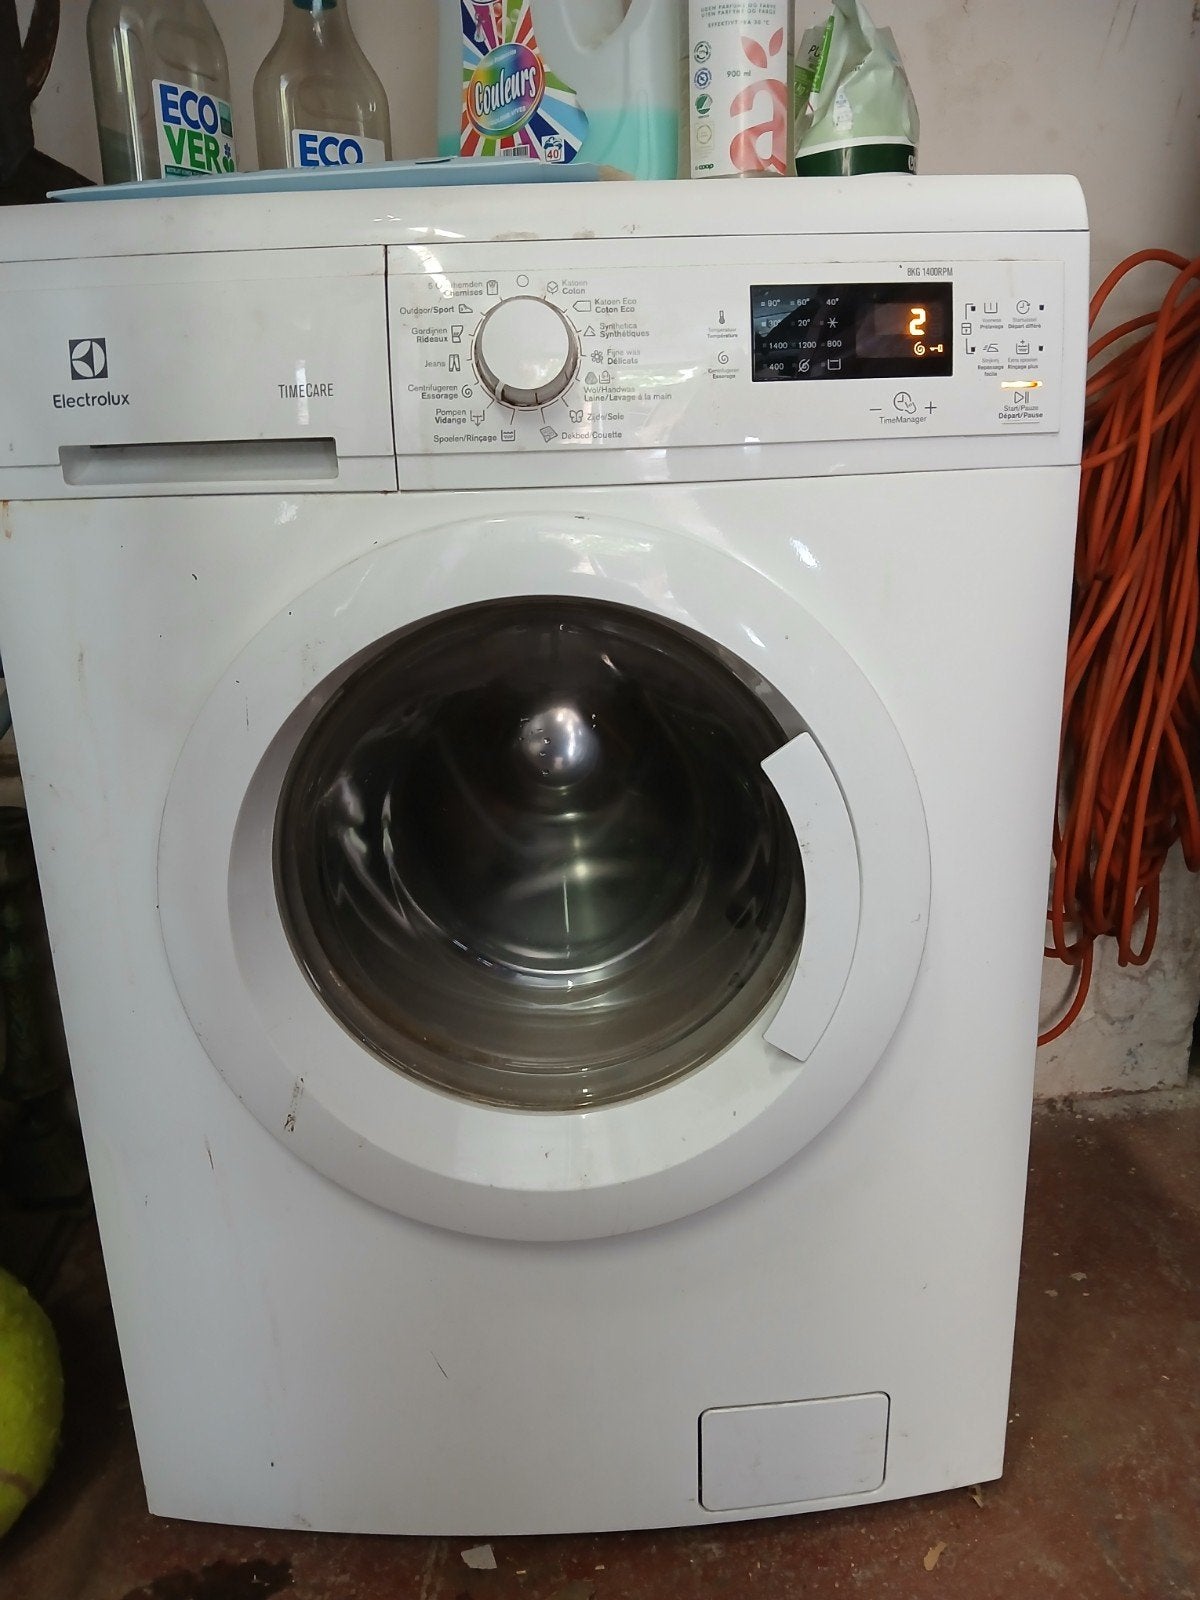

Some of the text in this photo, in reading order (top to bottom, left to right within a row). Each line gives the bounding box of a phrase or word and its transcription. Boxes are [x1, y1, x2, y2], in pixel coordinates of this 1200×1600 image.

[474, 66, 537, 117] Couleurs
[159, 84, 219, 135] ECO
[163, 125, 222, 174] VER
[299, 133, 363, 167] ECO
[922, 267, 953, 276] 1400RPM
[562, 287, 586, 295] Coton
[594, 297, 637, 306] Katoen Eco
[400, 306, 455, 315] Outdoor/Sport
[595, 306, 618, 314] Coton
[909, 307, 927, 336] 2
[411, 327, 448, 336] Gardijnen
[600, 330, 650, 339] Synthétiques
[416, 335, 449, 343] Rideaux
[799, 341, 817, 349] 1200
[827, 340, 842, 348] 800
[425, 360, 446, 368] Jeans
[769, 363, 785, 371] 400
[408, 384, 458, 393] Centrifugeren
[53, 391, 130, 409] Electrolux
[421, 392, 459, 400] Essorage
[584, 394, 636, 402] Laine/Lavage
[435, 408, 467, 416] Pompen
[998, 411, 1043, 420] Départ/Pause
[434, 416, 467, 425] Vidange
[879, 416, 927, 425] TimeManager
[433, 434, 498, 444] Spoelen/Rinçage
[561, 431, 623, 440] Dekbed/Couette
